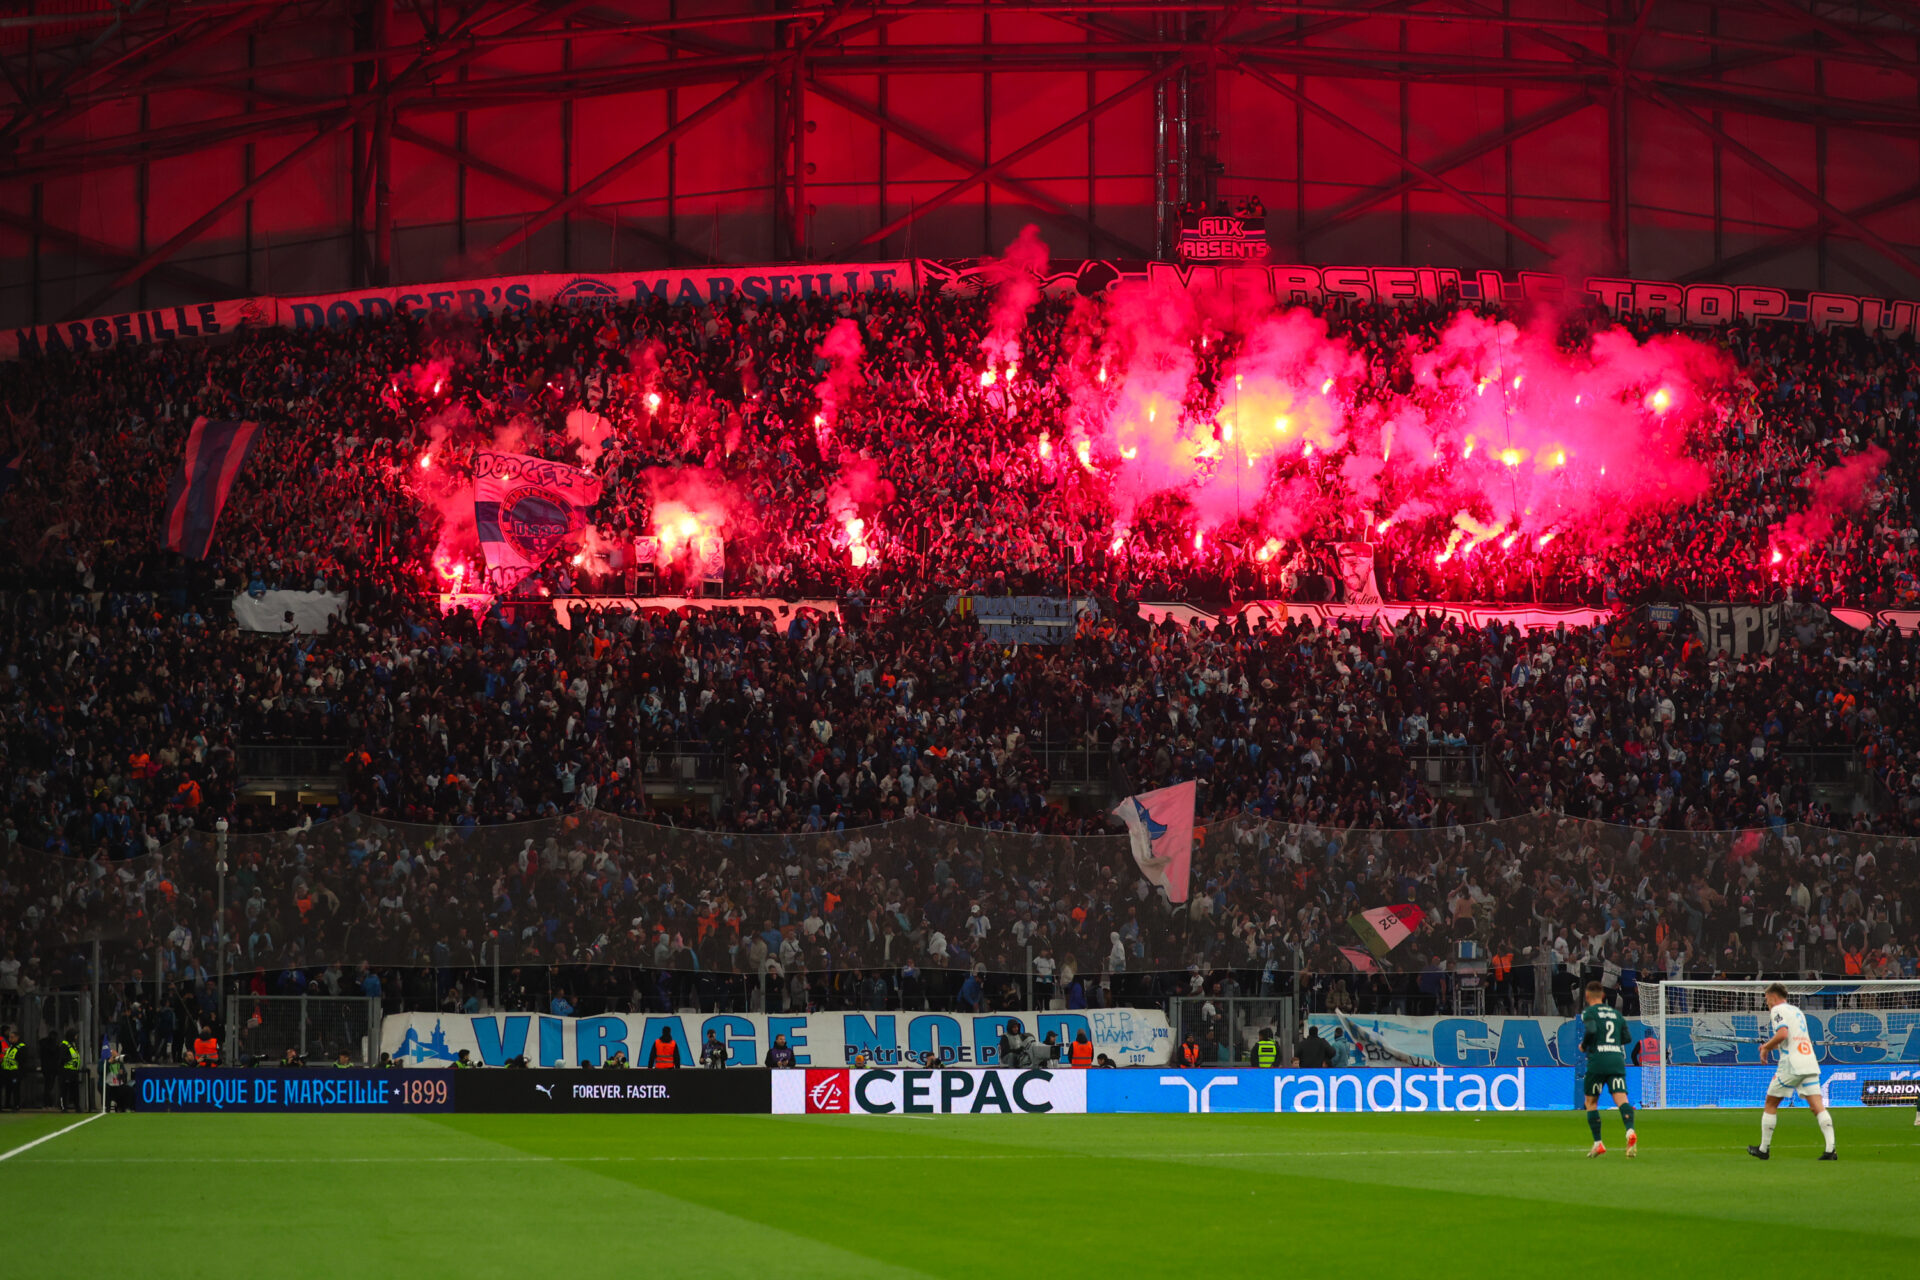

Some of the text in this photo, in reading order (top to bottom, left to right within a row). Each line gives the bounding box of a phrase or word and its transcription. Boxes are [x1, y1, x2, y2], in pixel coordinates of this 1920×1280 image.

[1199, 217, 1244, 238] AUX
[1182, 239, 1268, 260] ABSENTS
[635, 269, 900, 307] MARSEILLE
[1586, 277, 1786, 326] TROP
[1808, 292, 1920, 342] PU
[16, 302, 221, 359] MARSEILLE
[1093, 1012, 1131, 1030] RIP
[1605, 1021, 1616, 1043] 2
[471, 1015, 812, 1067] VIRAGE
[1095, 1030, 1134, 1043] HAYAT
[940, 1046, 972, 1062] DE
[142, 1078, 448, 1107] OLYMPIQUE DE MARSEILLE 1899
[573, 1084, 670, 1099] FOREVER. FASTER.
[855, 1069, 1054, 1113] CEPAC
[1273, 1066, 1526, 1112] randstad
